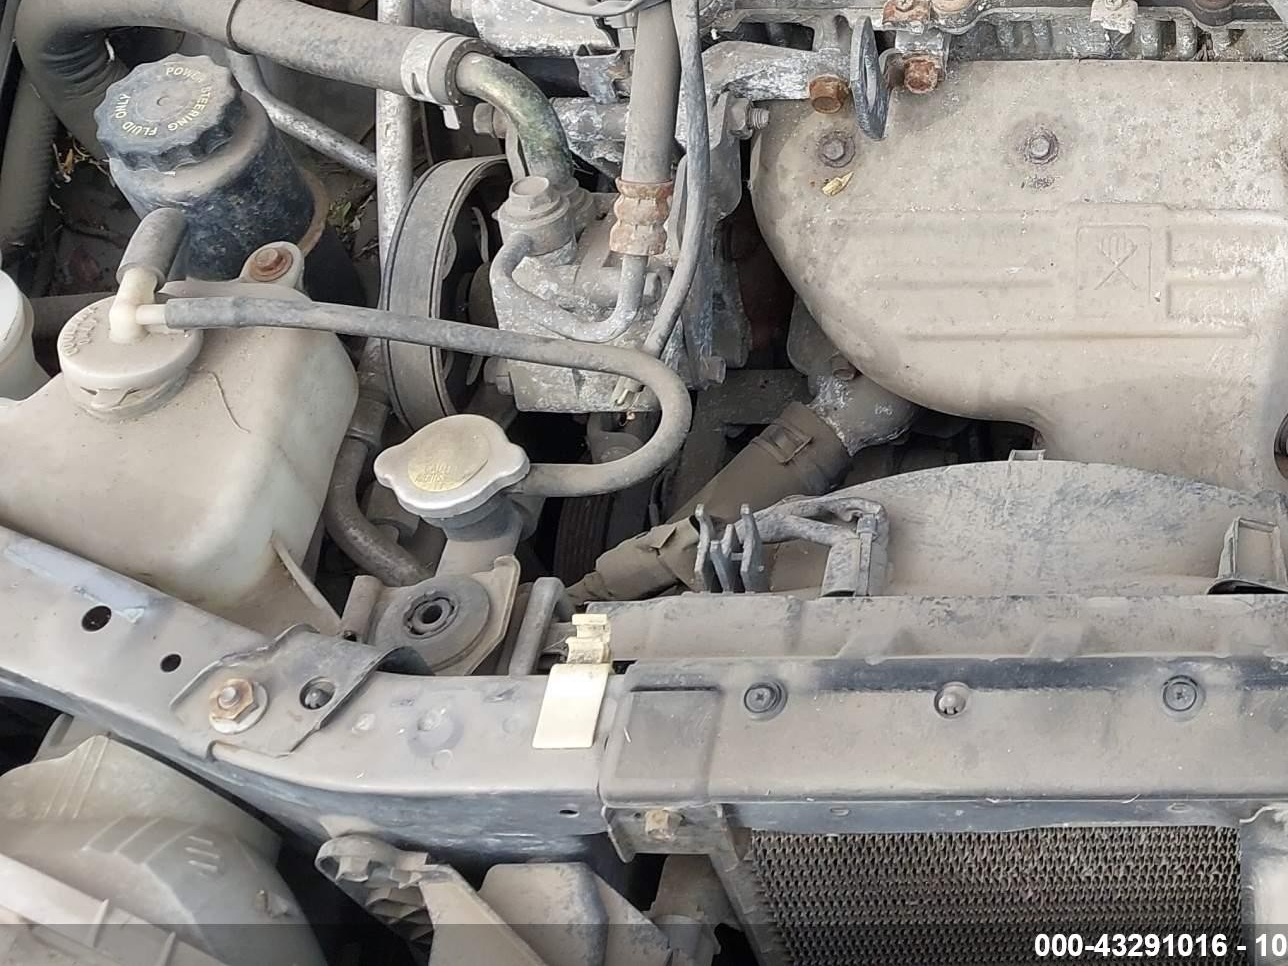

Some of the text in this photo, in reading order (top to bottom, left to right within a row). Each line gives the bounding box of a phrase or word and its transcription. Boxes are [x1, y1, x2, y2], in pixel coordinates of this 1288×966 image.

[165, 66, 205, 84] POWER
[115, 93, 132, 120] ONLY
[167, 84, 213, 132] STEERING
[122, 120, 159, 137] FLUID
